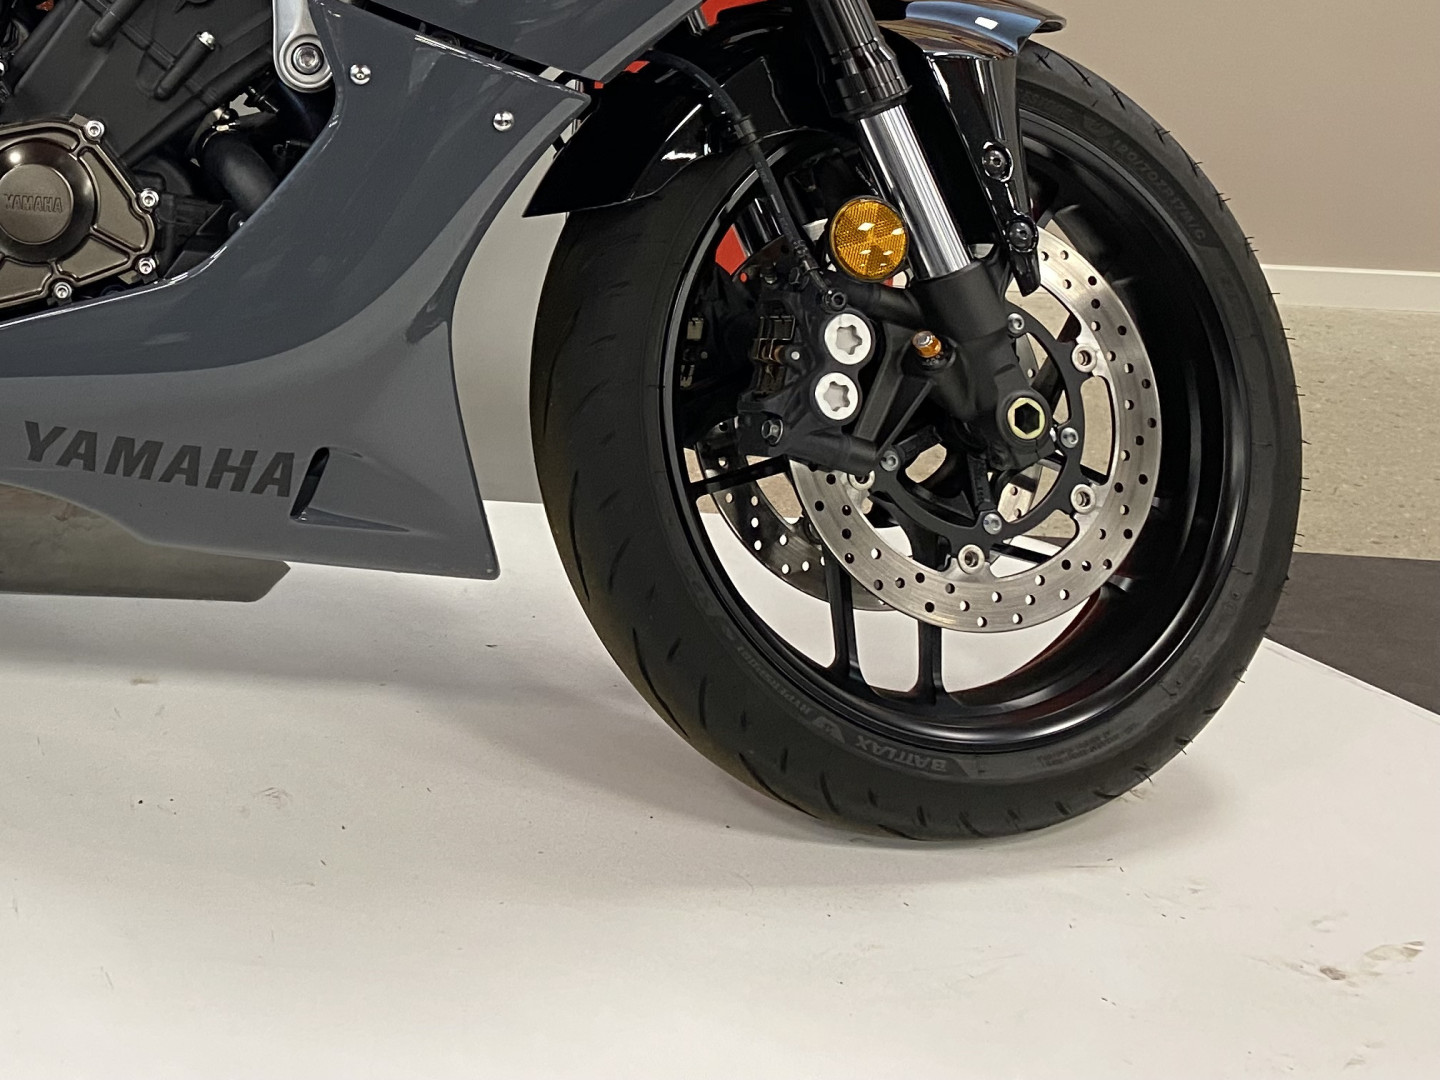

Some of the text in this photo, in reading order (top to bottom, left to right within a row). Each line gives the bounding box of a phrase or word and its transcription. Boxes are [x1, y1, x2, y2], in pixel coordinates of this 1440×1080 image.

[3, 193, 63, 214] YAMAHA
[24, 420, 297, 498] YAMAHA
[854, 733, 949, 774] BATTLAX
